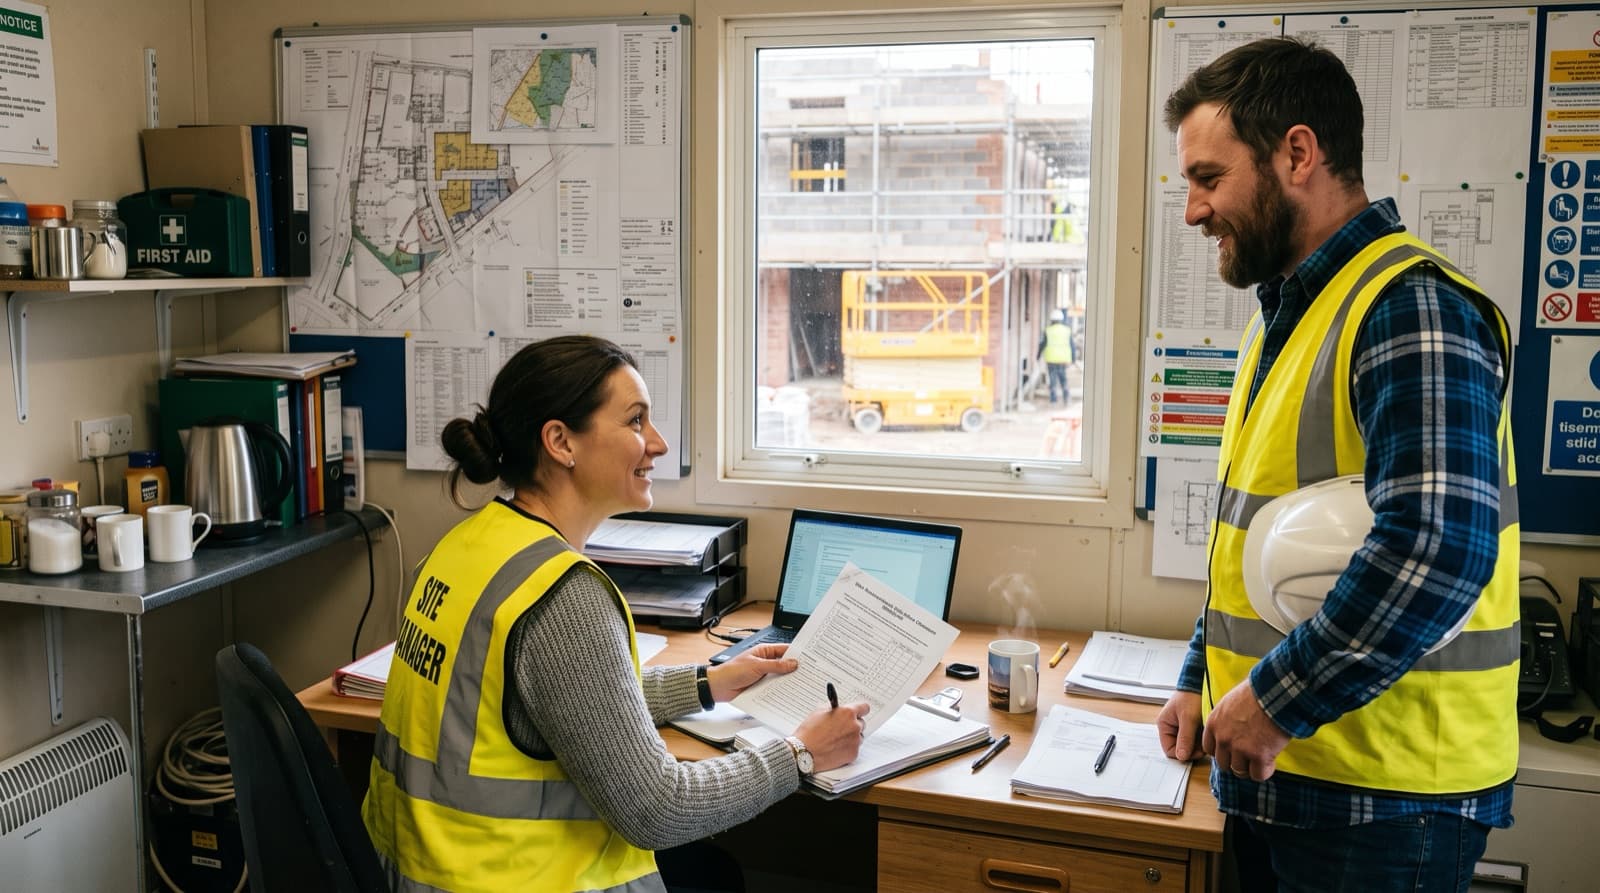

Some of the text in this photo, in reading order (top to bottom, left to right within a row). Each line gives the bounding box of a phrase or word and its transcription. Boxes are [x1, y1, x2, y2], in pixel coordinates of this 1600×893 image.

[0, 14, 38, 33] NOTICE
[137, 248, 212, 263] FIRST AID
[1559, 421, 1600, 433] tisem
[416, 575, 451, 622] SITE
[396, 616, 447, 686] ANAGER
